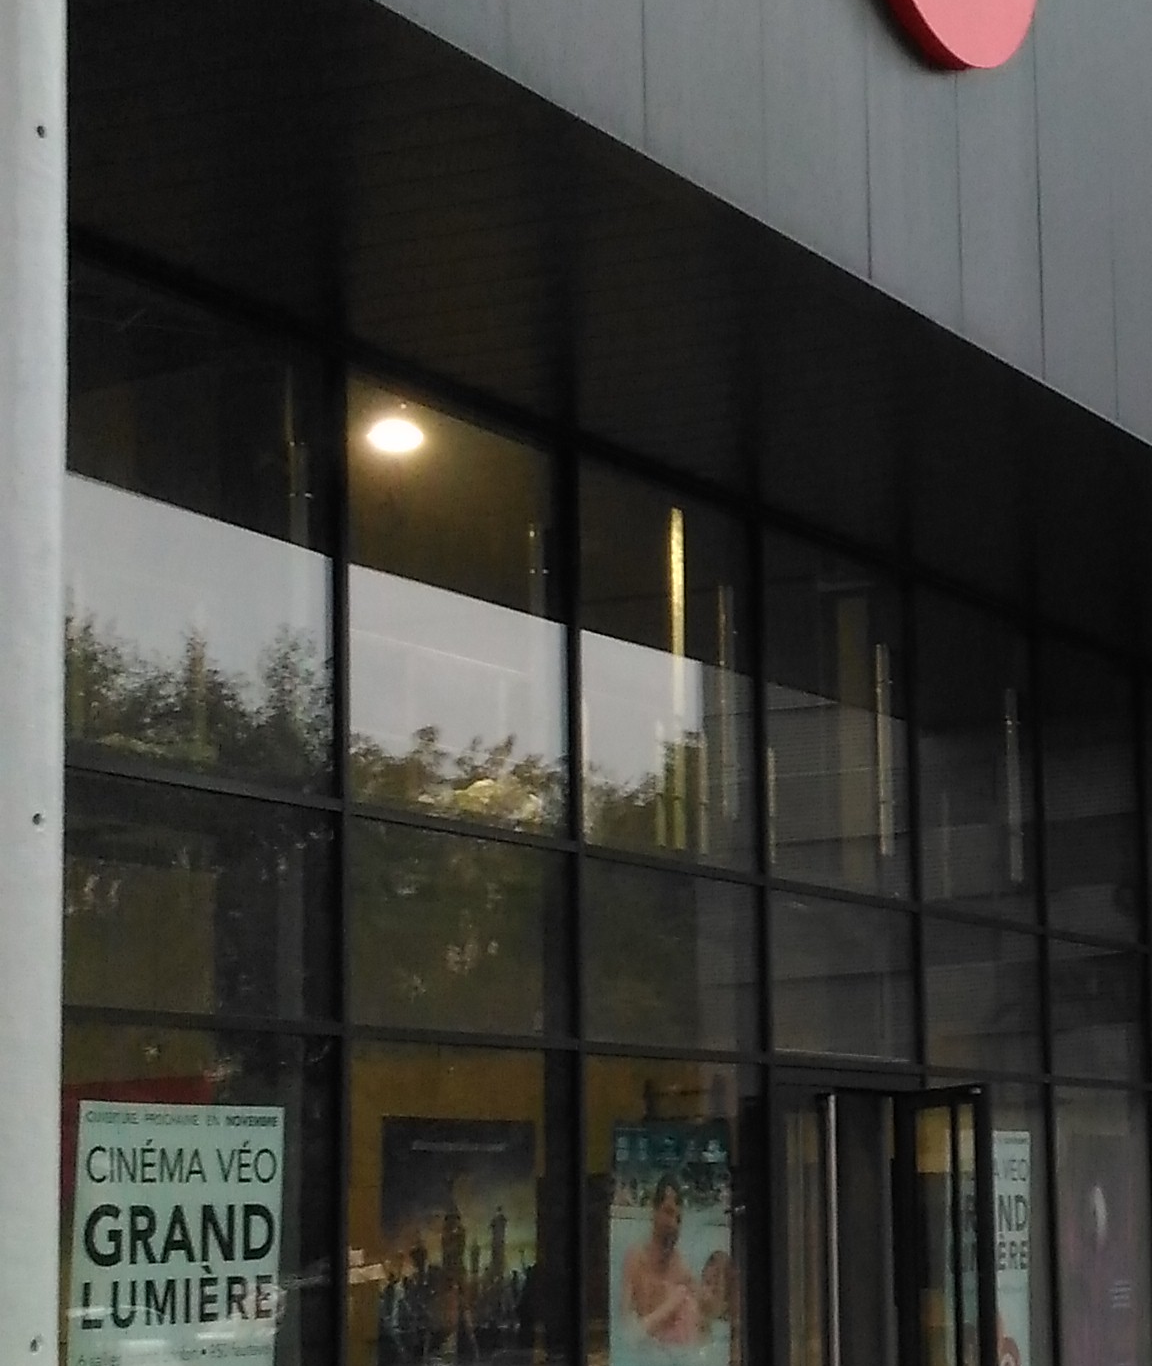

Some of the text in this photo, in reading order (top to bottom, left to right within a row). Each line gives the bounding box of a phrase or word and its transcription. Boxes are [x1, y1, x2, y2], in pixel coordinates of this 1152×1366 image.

[225, 1115, 279, 1127] NOVEMBRE
[86, 1139, 277, 1184] CINÉMA VÉO
[84, 1203, 275, 1268] GRAND
[81, 1264, 273, 1330] LUMIÈRE
